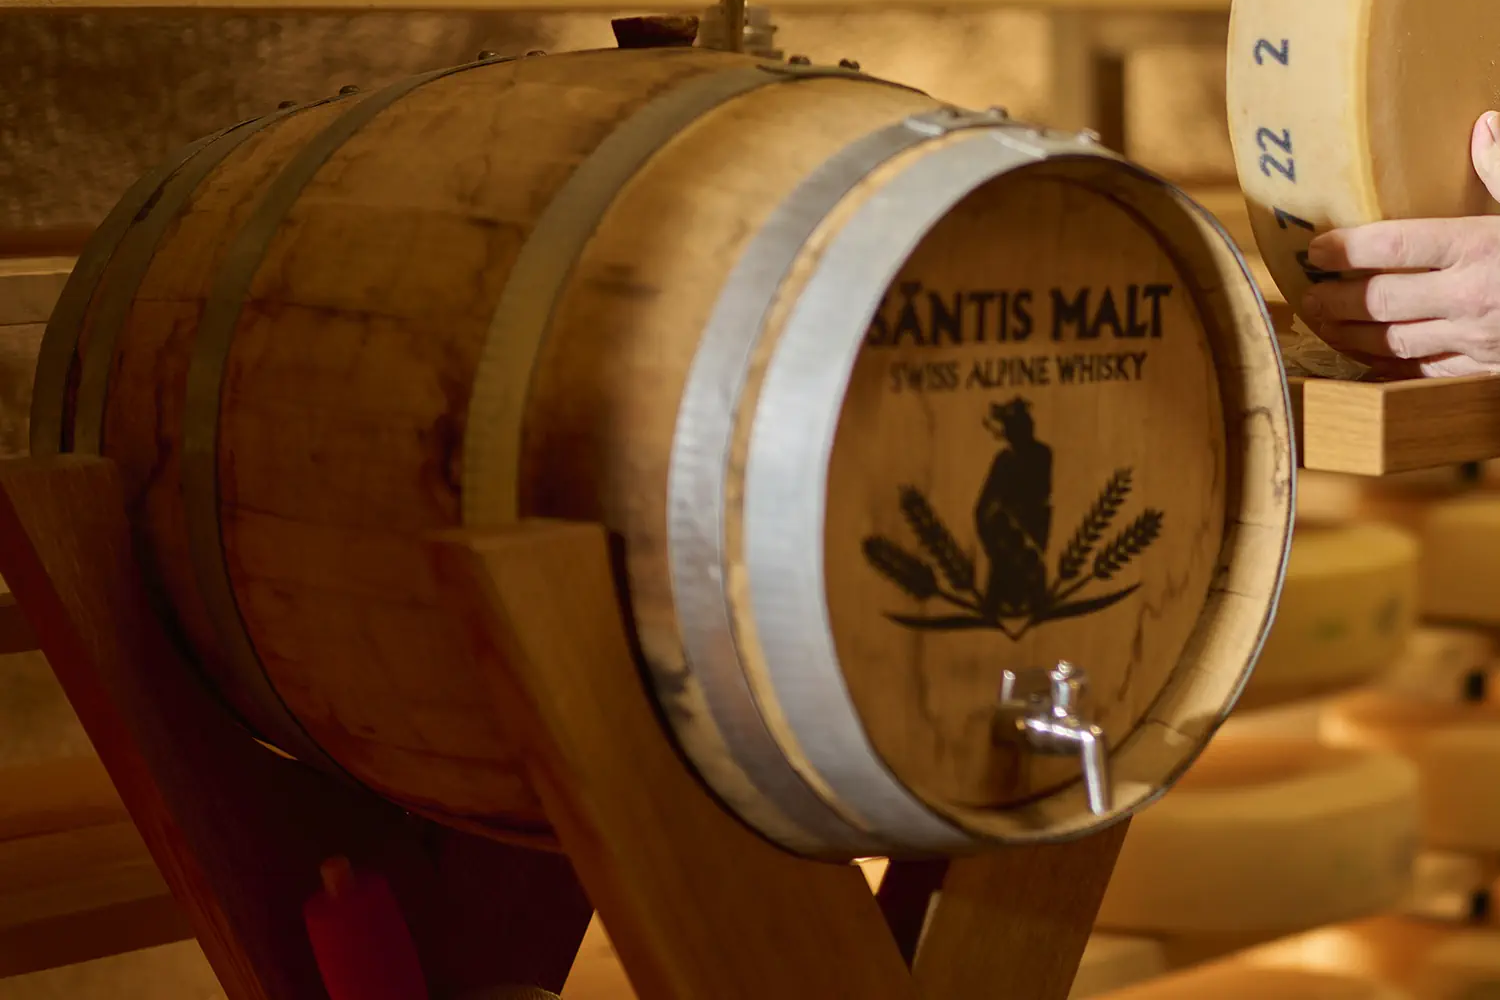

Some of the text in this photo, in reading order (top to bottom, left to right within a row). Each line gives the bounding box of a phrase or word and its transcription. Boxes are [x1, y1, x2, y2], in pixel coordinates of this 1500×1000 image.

[1253, 38, 1290, 66] 2
[1256, 126, 1297, 184] 22
[1049, 284, 1174, 341] MALT
[889, 351, 1148, 393] SWISS ALPINE WHISKY
